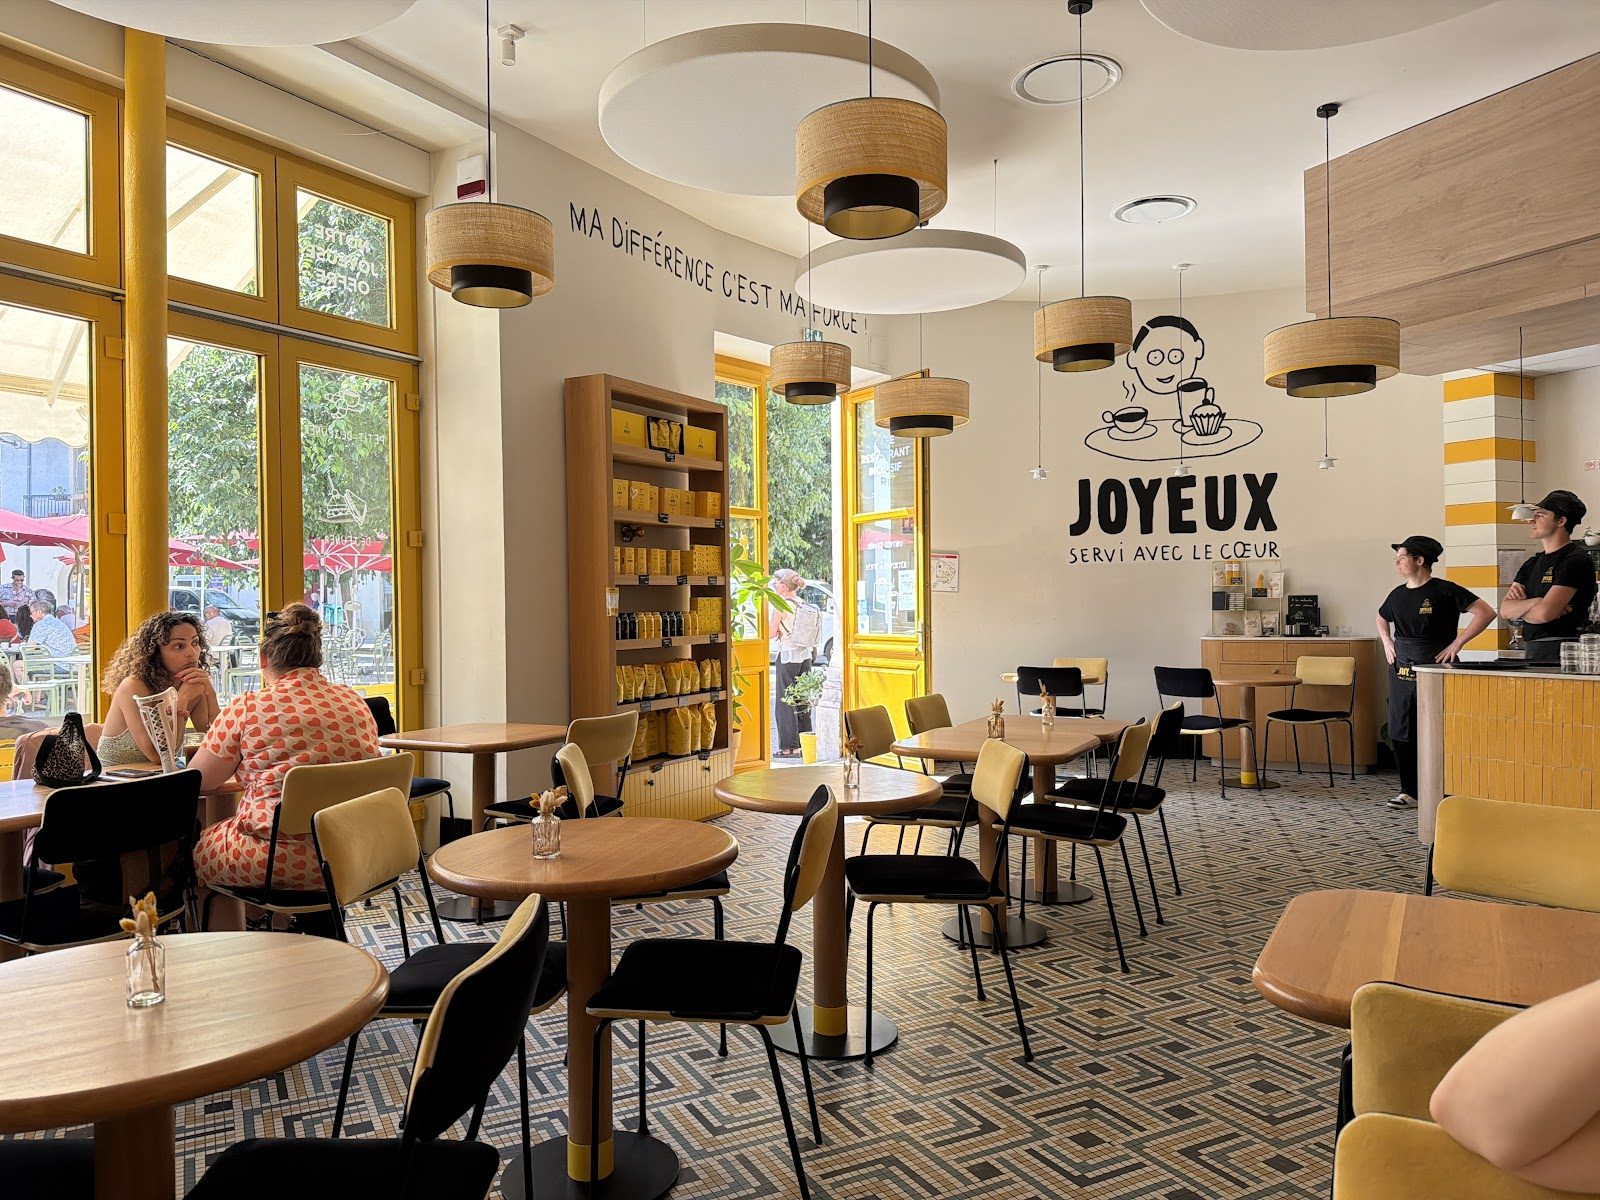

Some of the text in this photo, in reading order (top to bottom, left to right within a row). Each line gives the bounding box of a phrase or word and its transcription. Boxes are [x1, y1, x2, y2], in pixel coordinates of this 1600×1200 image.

[569, 202, 604, 241] MA
[722, 270, 772, 309] C'EST
[780, 288, 806, 318] MA
[812, 303, 858, 335] FORCE
[860, 445, 911, 465] RESTRANT
[1069, 472, 1279, 537] JOYEUX
[1069, 540, 1281, 564] SERVi AVEC LE CŒUR
